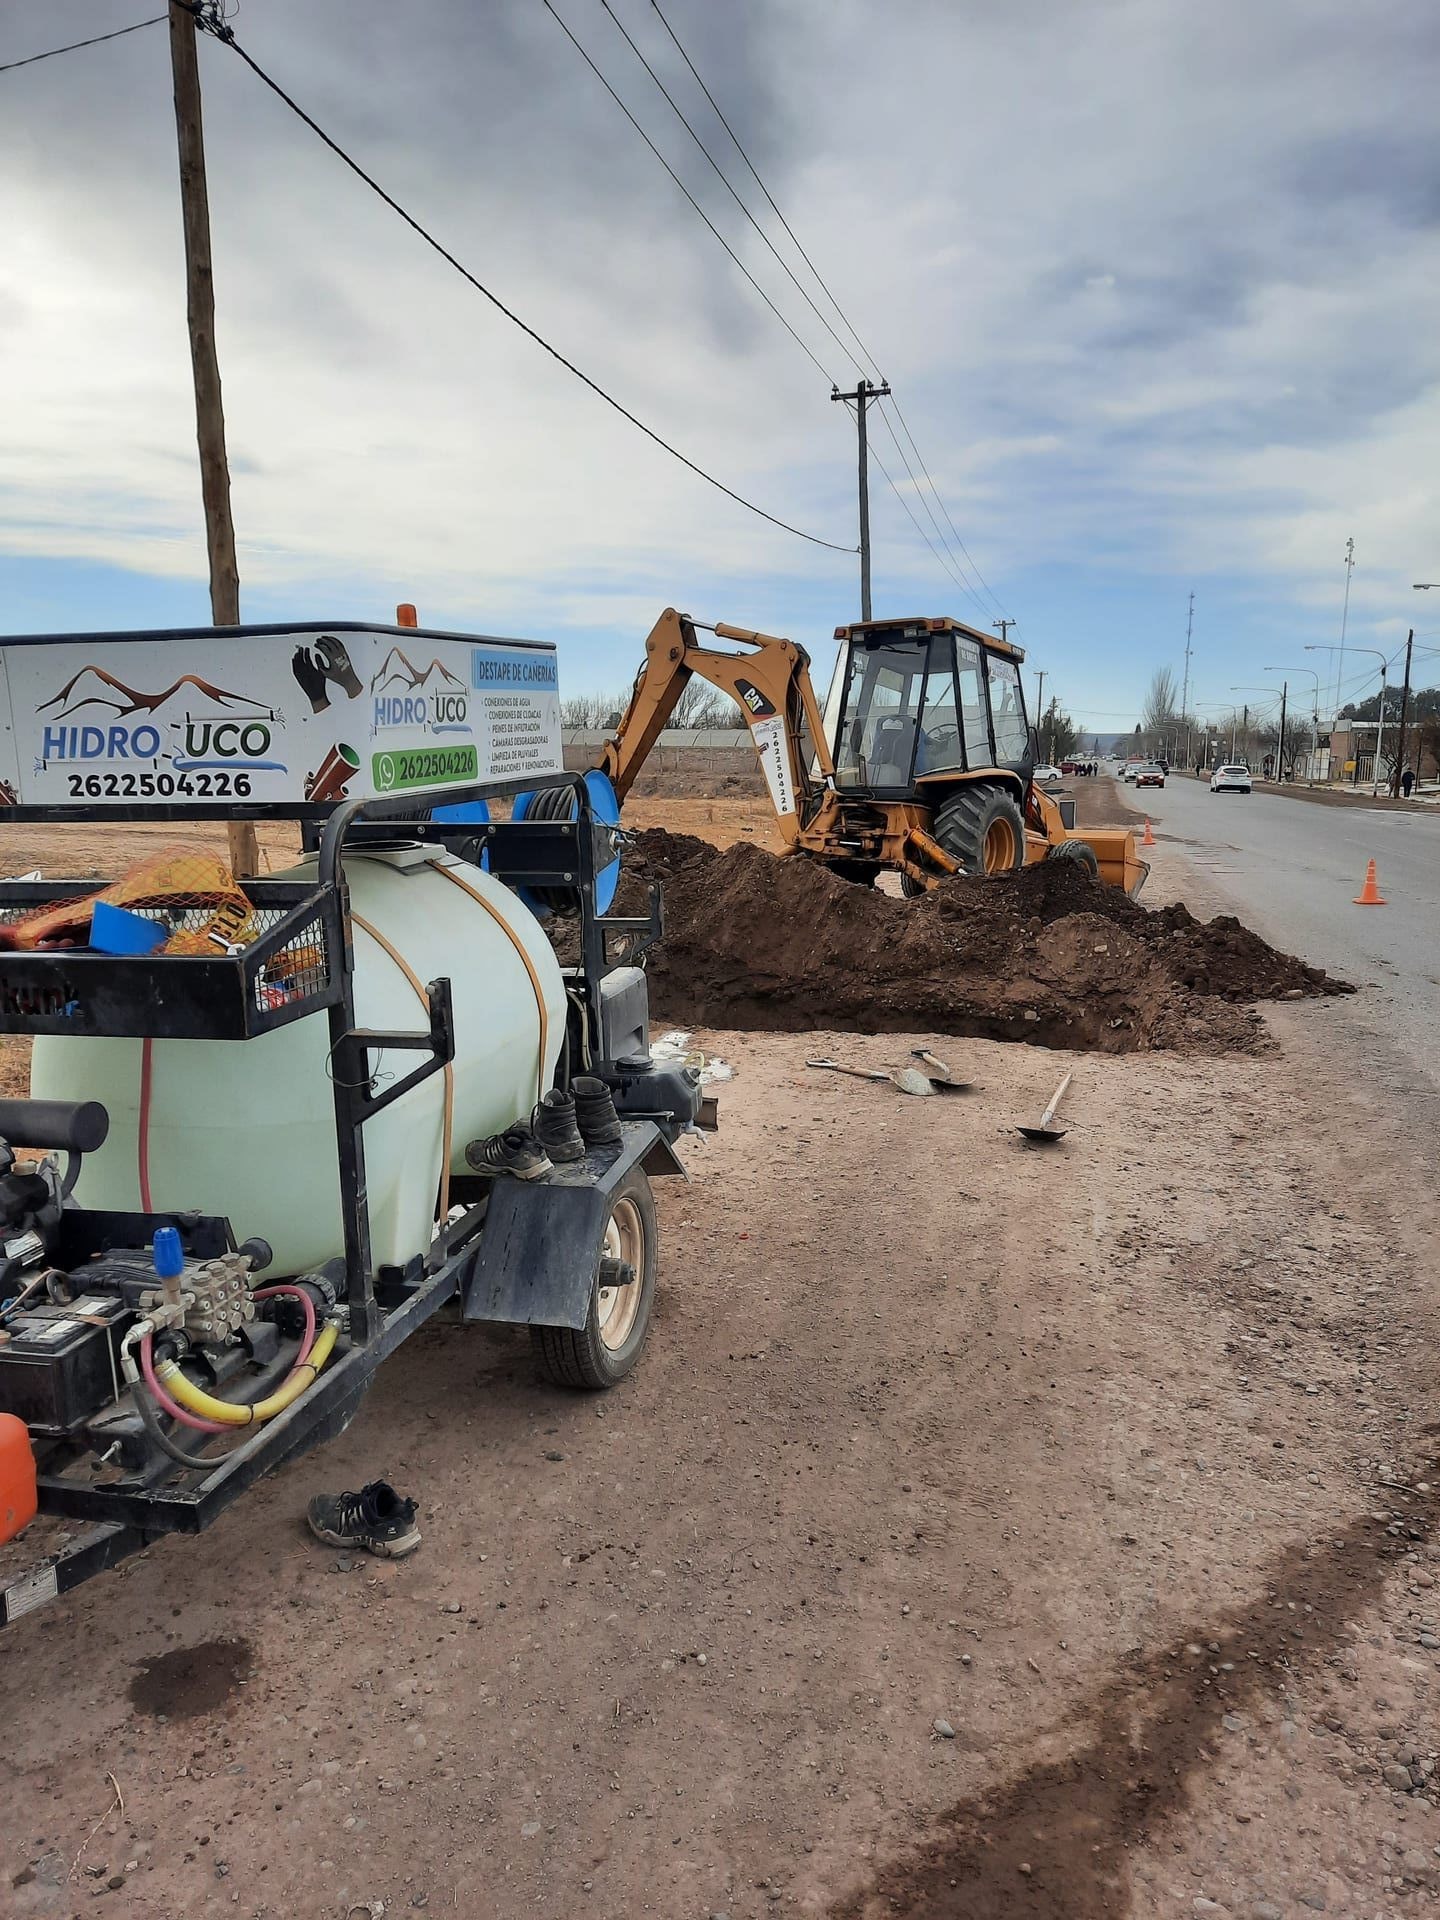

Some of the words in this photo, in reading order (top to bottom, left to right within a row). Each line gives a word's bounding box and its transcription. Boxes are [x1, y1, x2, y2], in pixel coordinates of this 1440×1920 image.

[479, 661, 511, 681] DESTAPE
[512, 663, 521, 682] DE
[522, 660, 556, 683] CAÑERÍAS
[374, 696, 427, 726] HIDRO
[435, 696, 467, 723] UCO
[484, 697, 512, 707] CONEXIONES
[512, 697, 519, 707] DE
[743, 687, 764, 713] CAT
[488, 710, 516, 720] CONEXIONES
[516, 710, 522, 719] DE
[522, 710, 542, 719] CLOACAS
[492, 723, 507, 734] PEINES
[507, 723, 513, 733] DE
[43, 724, 161, 760] HIDRO
[185, 722, 271, 758] UCO
[513, 735, 549, 746] DESGRASADORAS
[400, 751, 473, 781] 2622504226
[491, 751, 511, 762] LIMPIEZA
[511, 750, 518, 760] DE
[517, 748, 539, 759] PLUVIALES
[490, 762, 521, 775] REPARACIONES
[772, 731, 788, 812] 2622504226
[68, 773, 252, 798] 2622504226
